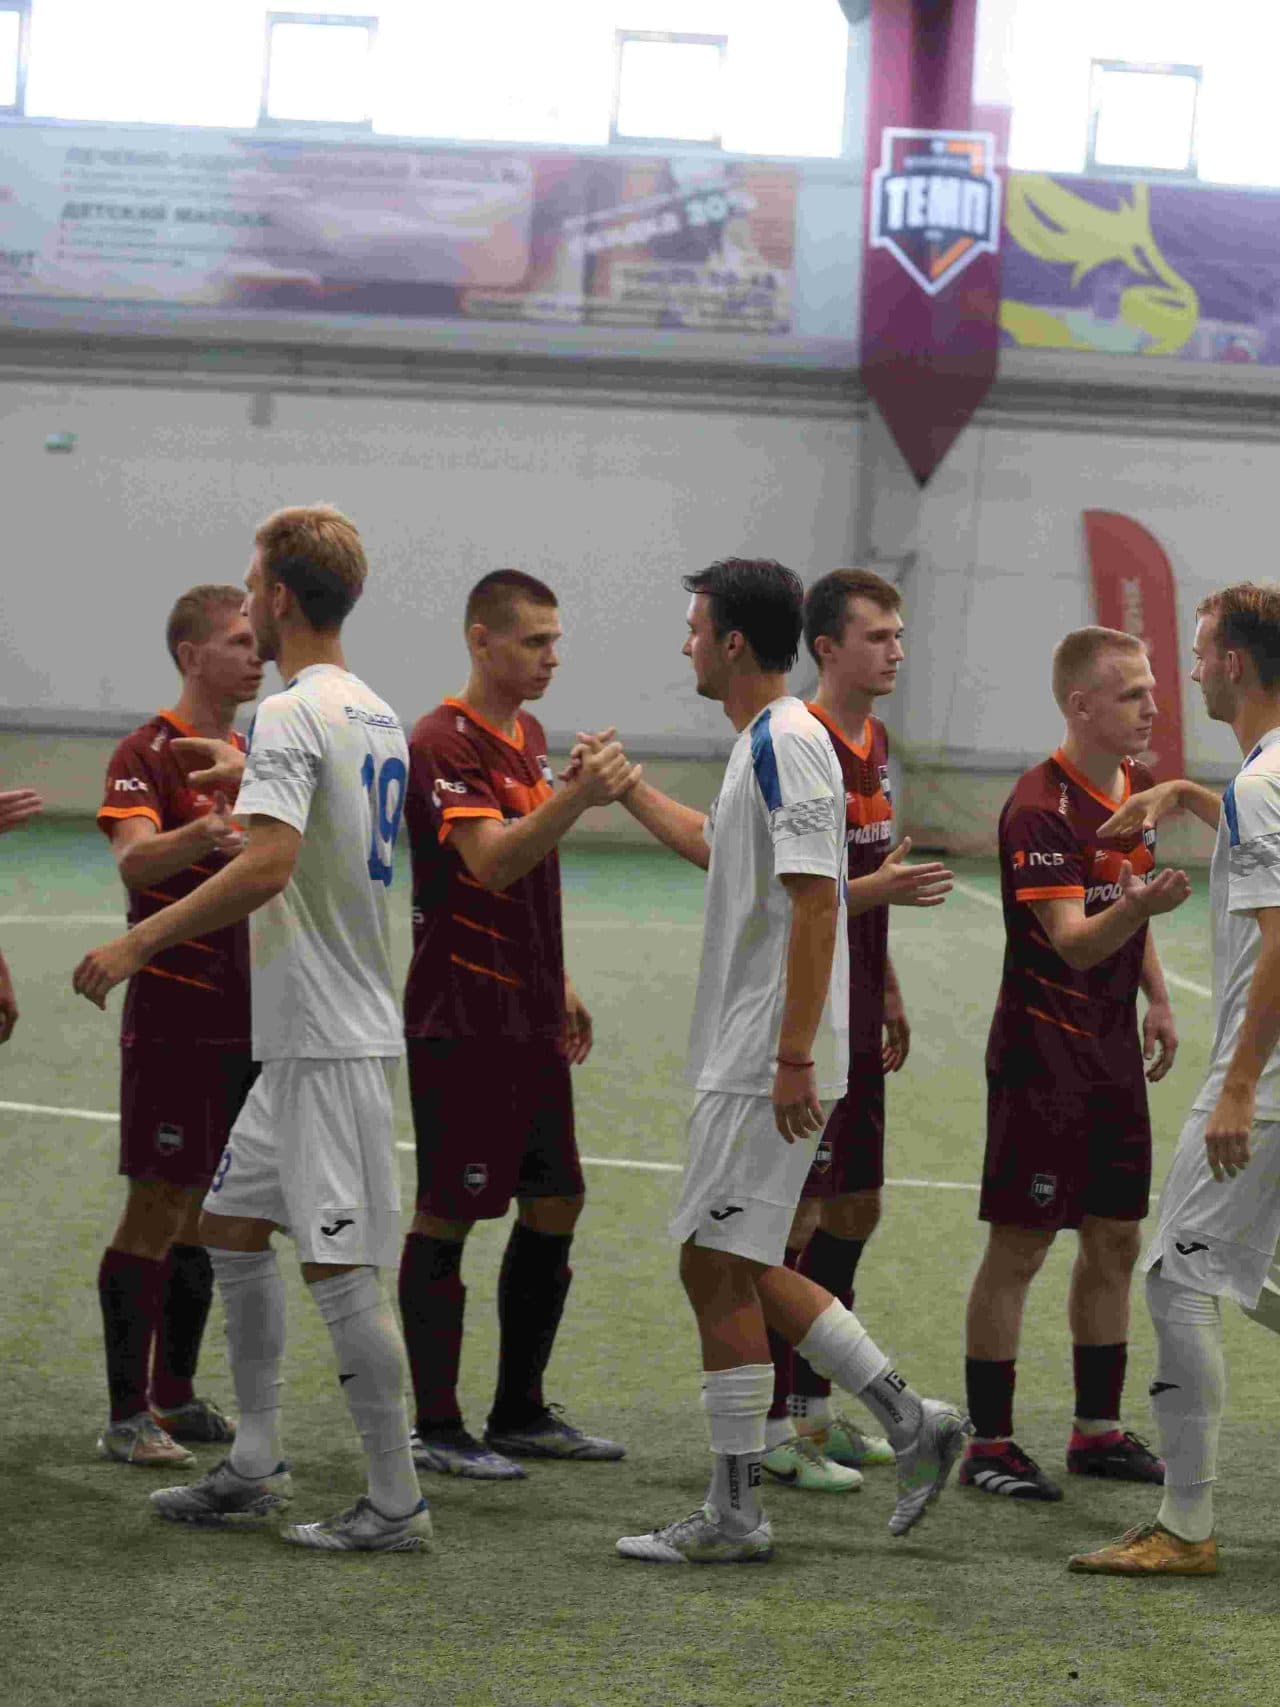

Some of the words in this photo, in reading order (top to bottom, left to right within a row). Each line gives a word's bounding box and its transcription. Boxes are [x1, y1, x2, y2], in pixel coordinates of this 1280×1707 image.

[884, 176, 988, 235] ТЕМП
[361, 751, 407, 888] 19
[1028, 851, 1065, 867] ПСБ
